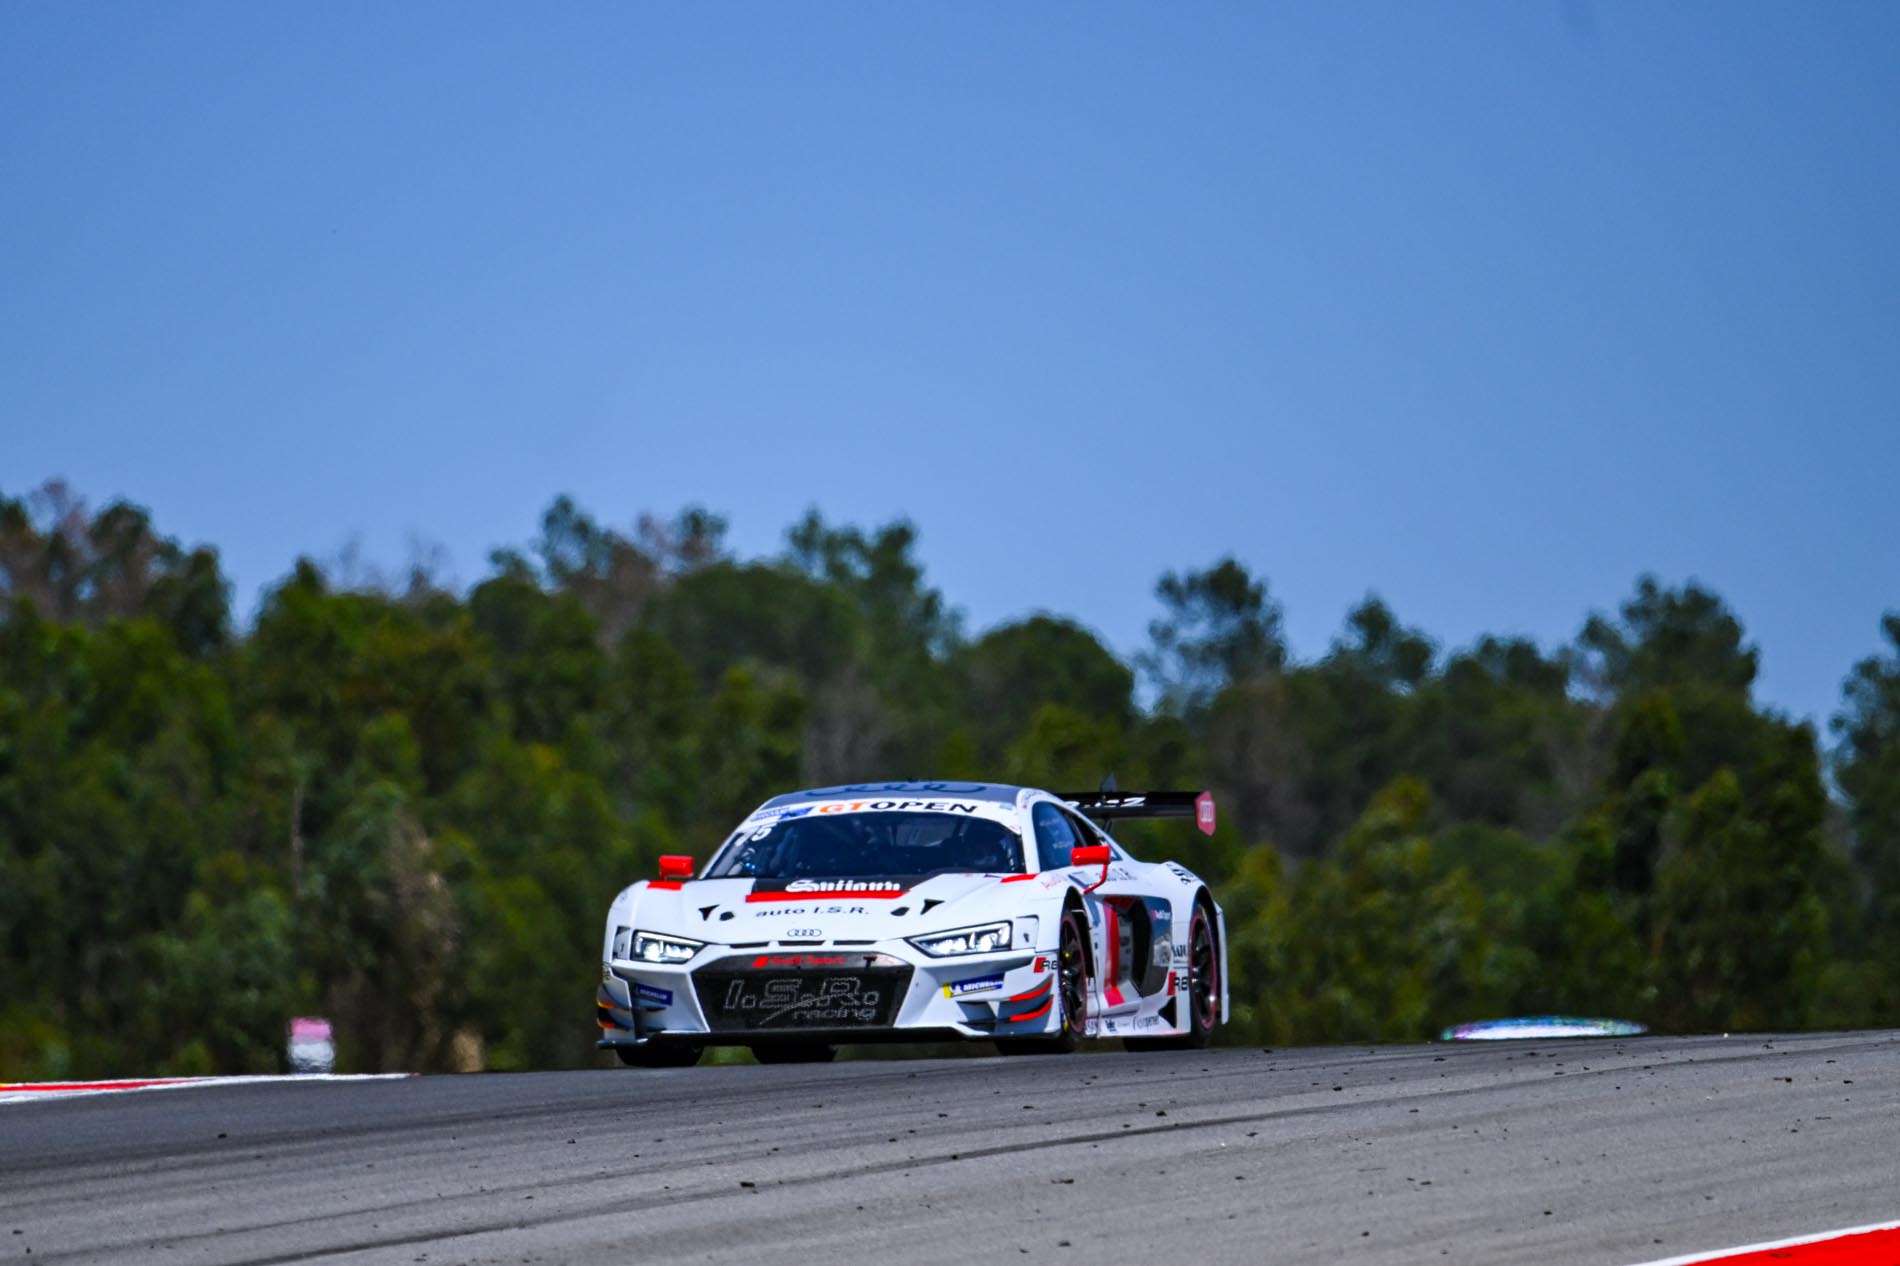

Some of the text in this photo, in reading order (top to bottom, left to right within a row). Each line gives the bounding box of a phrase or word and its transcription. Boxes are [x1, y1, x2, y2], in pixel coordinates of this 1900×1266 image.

[756, 908, 805, 917] auto
[772, 955, 845, 967] Audi Sport
[793, 1007, 877, 1021] racing
